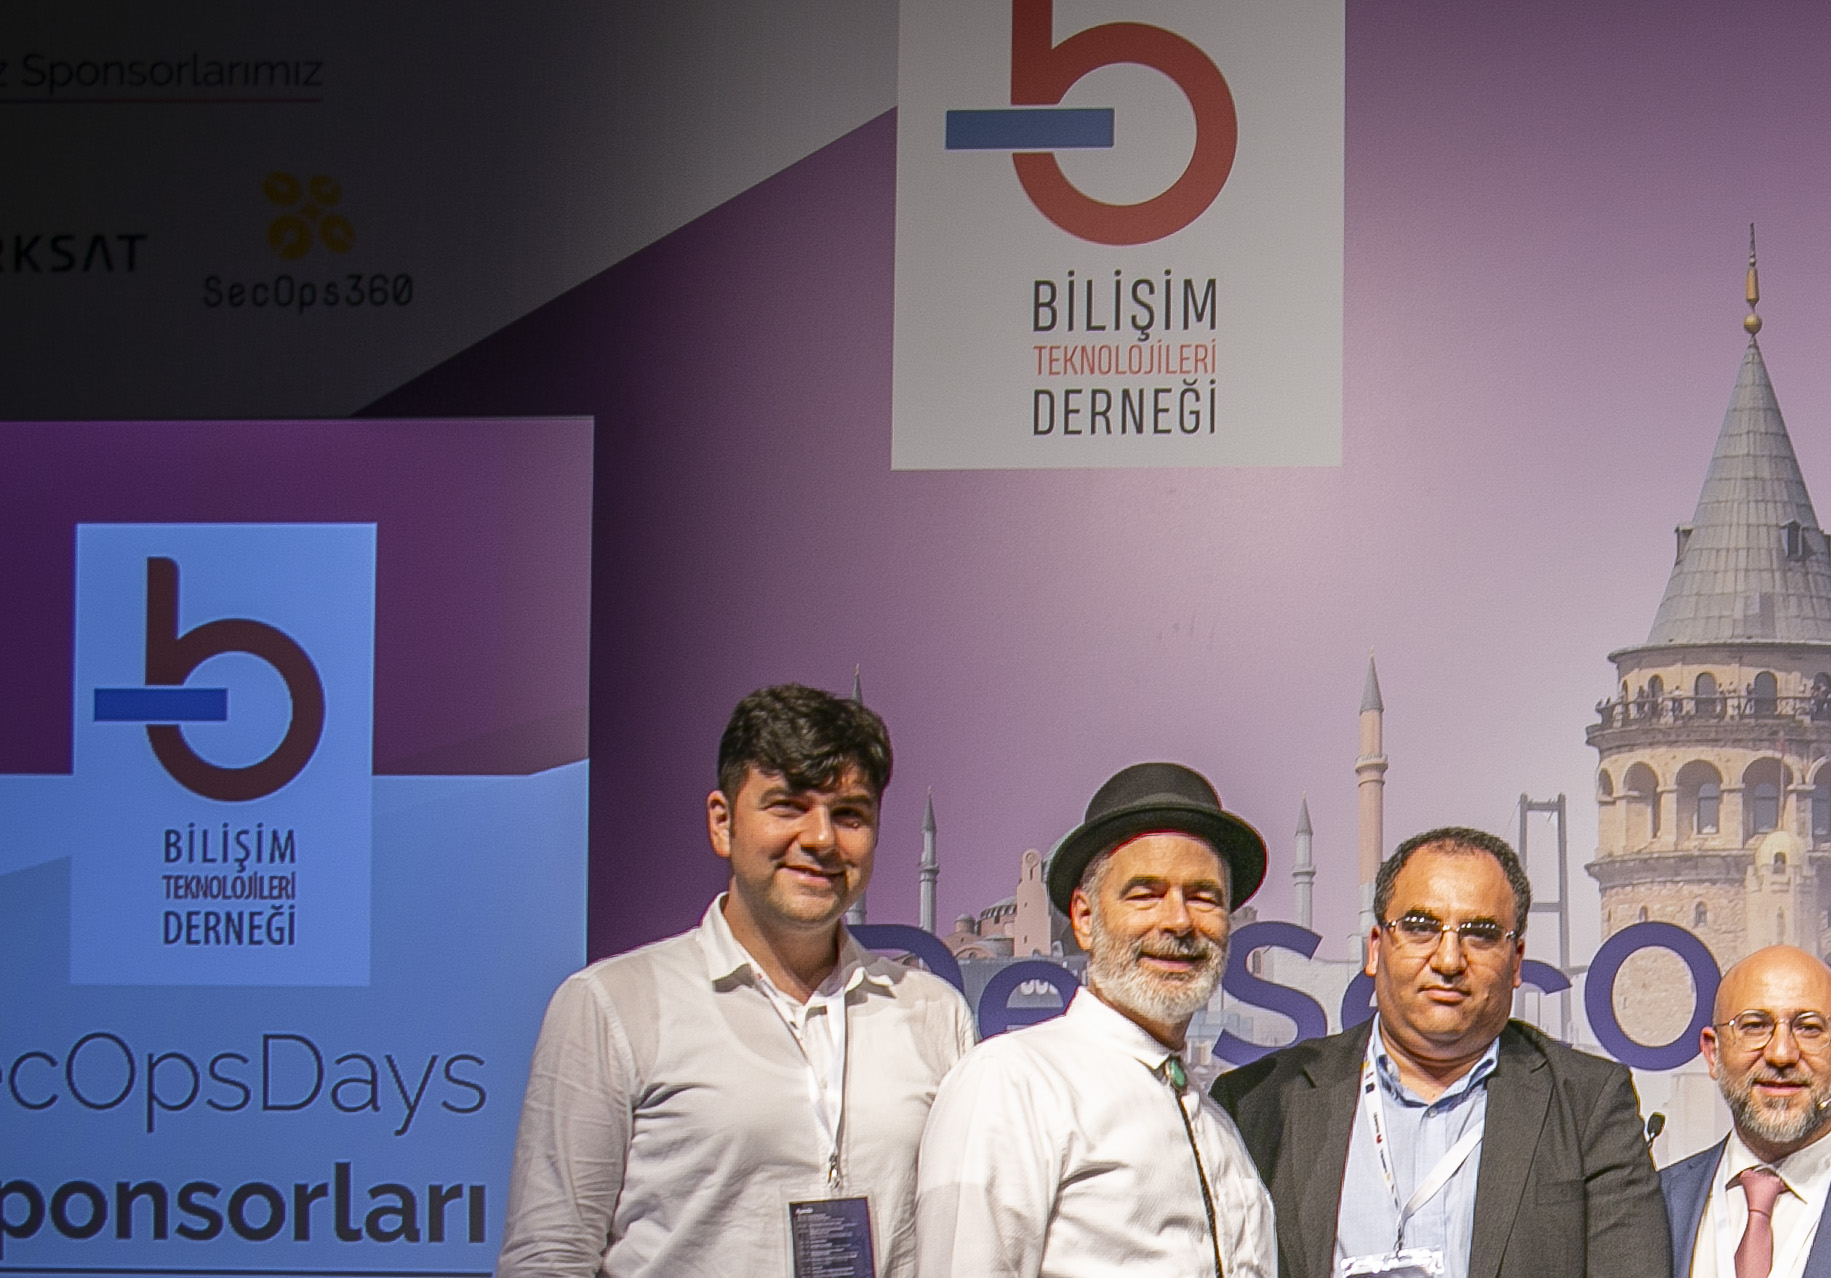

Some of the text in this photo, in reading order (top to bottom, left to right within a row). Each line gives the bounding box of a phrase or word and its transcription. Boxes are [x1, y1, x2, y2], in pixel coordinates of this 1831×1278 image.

[22, 53, 323, 95] Sponsorlarımız
[0, 235, 147, 272] KSAT
[203, 273, 413, 315] SecOps360
[1033, 269, 1217, 342] BİLİŞİM
[1032, 339, 1216, 376] TEKNOLOJİLERİ
[1033, 378, 1216, 436] DERNEĞİ
[163, 822, 297, 874] BİLİŞİM
[162, 872, 296, 900] TEKNOLOJİLERİ
[162, 904, 297, 946] DERNEĞİ
[0, 1031, 487, 1137] cOpsDays
[0, 1162, 486, 1261] ponsorları
